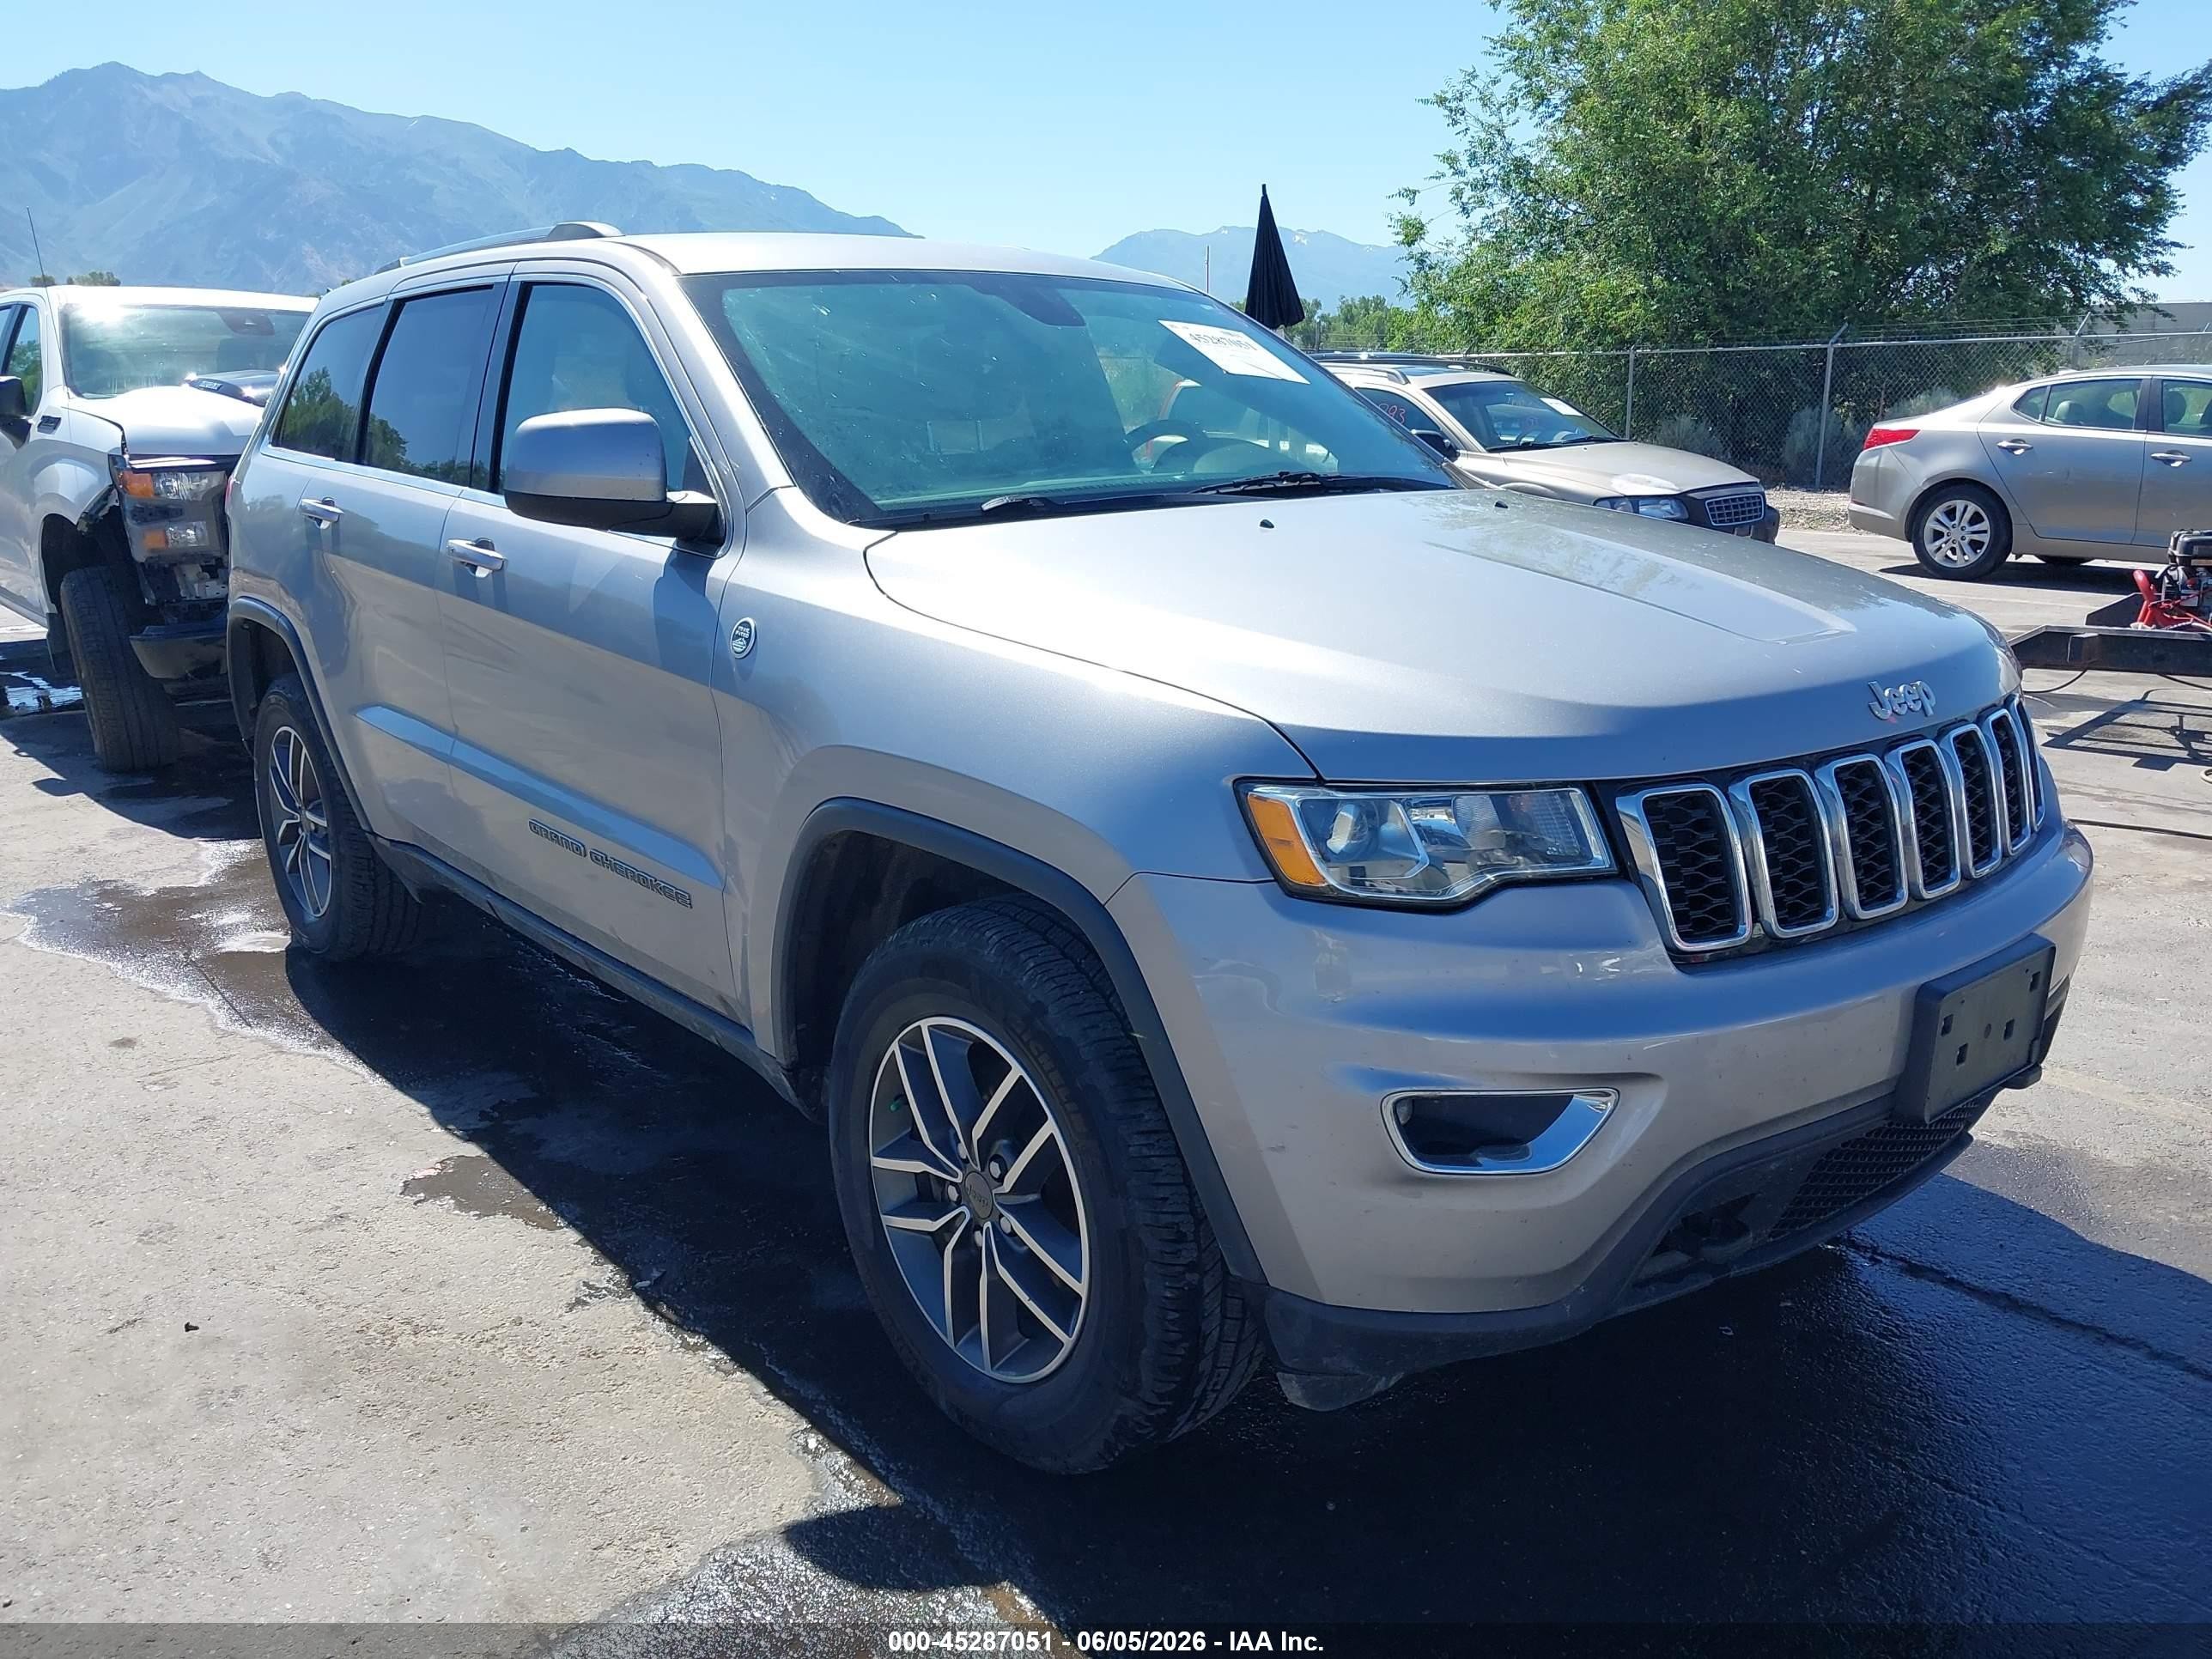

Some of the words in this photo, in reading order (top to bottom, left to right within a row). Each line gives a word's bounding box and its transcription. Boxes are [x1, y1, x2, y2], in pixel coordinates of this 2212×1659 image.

[1868, 680, 1936, 720] Jeep
[528, 818, 587, 858] GRAND
[589, 848, 693, 908] CHEROKEE
